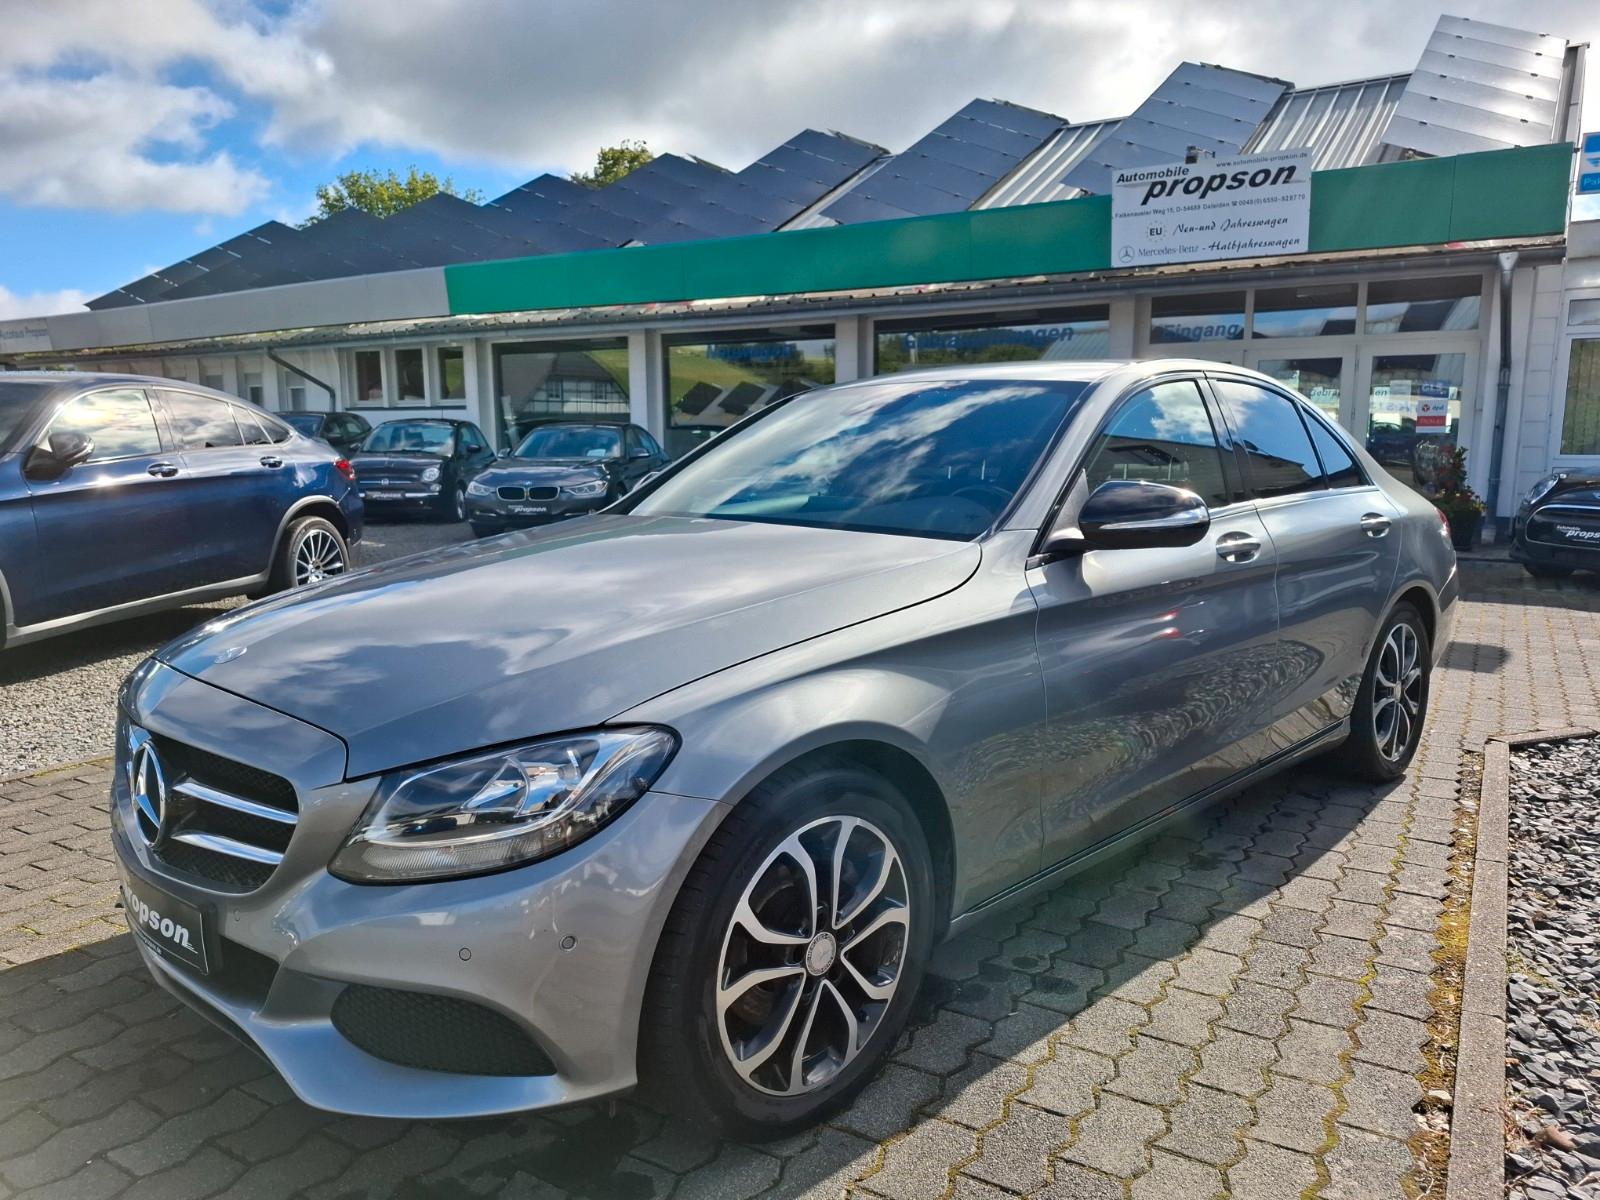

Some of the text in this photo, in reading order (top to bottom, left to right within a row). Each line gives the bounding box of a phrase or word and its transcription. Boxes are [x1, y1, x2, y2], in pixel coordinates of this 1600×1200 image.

[1116, 166, 1190, 184] Automobile
[1140, 165, 1297, 206] propson
[1149, 227, 1163, 236] EU
[1220, 217, 1288, 232] Jahreswagen
[1138, 245, 1199, 257] Mercedes-Benz
[1162, 323, 1240, 341] Eingang
[123, 885, 189, 947] ropson
